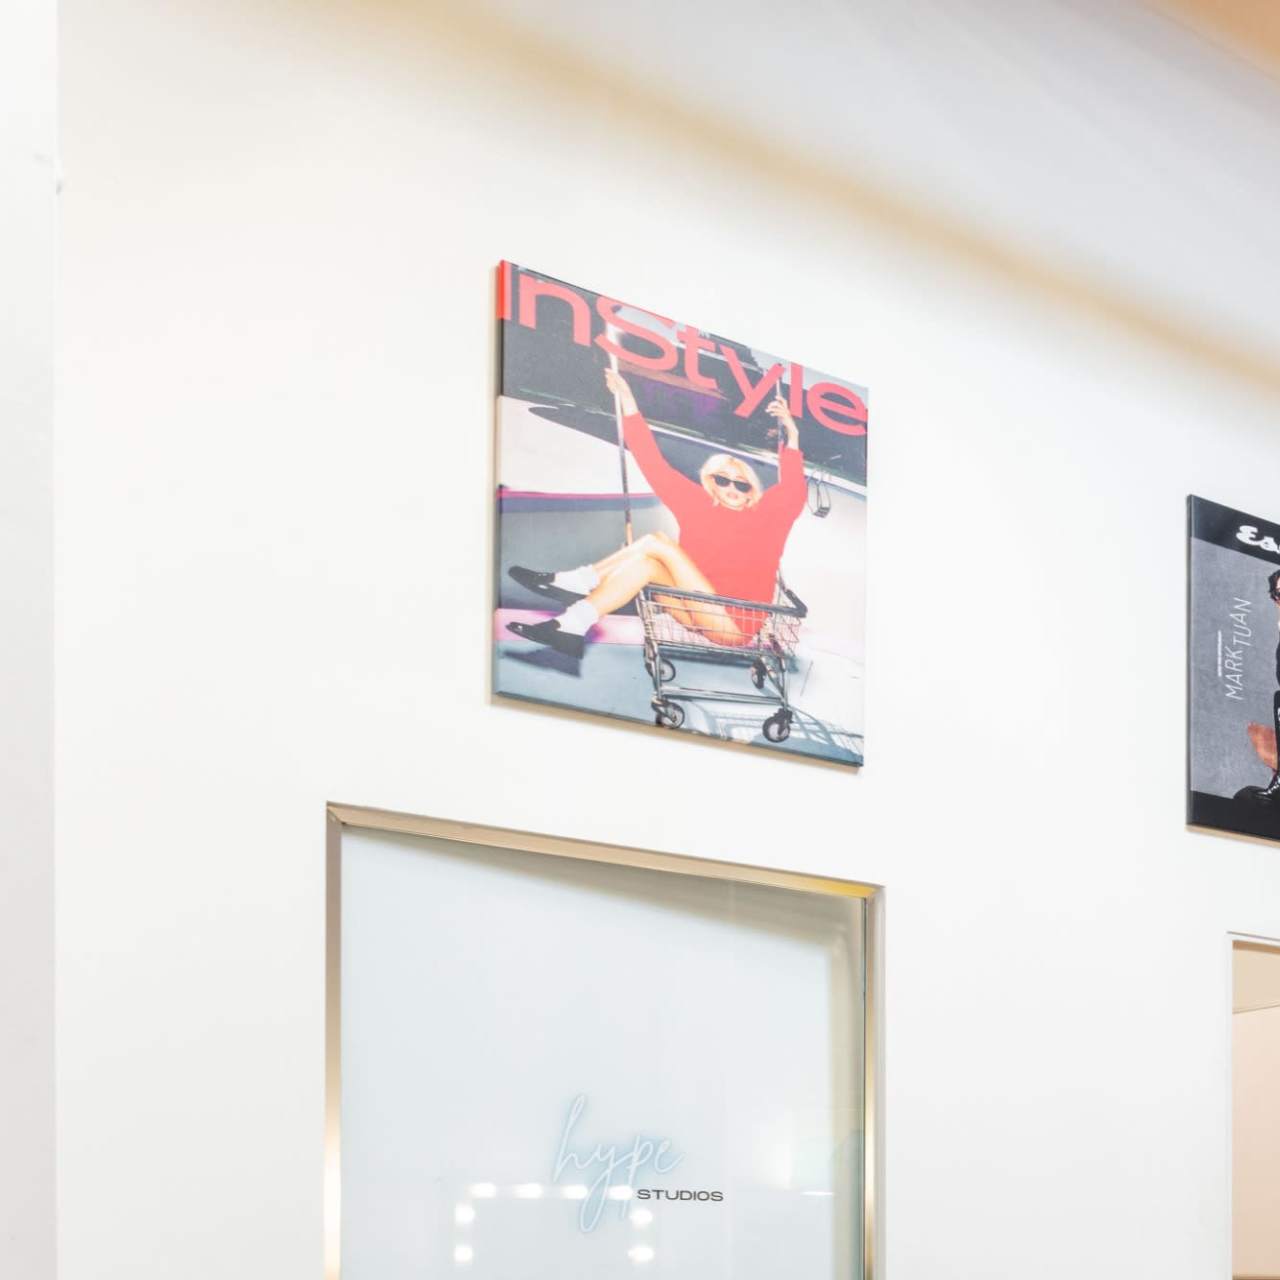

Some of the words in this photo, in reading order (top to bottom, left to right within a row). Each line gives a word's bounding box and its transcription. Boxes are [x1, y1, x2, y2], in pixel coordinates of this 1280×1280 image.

[498, 260, 869, 436] InStyle
[1230, 597, 1252, 646] TUAN
[1225, 645, 1243, 700] MARK
[637, 1189, 724, 1201] STUDIOS
